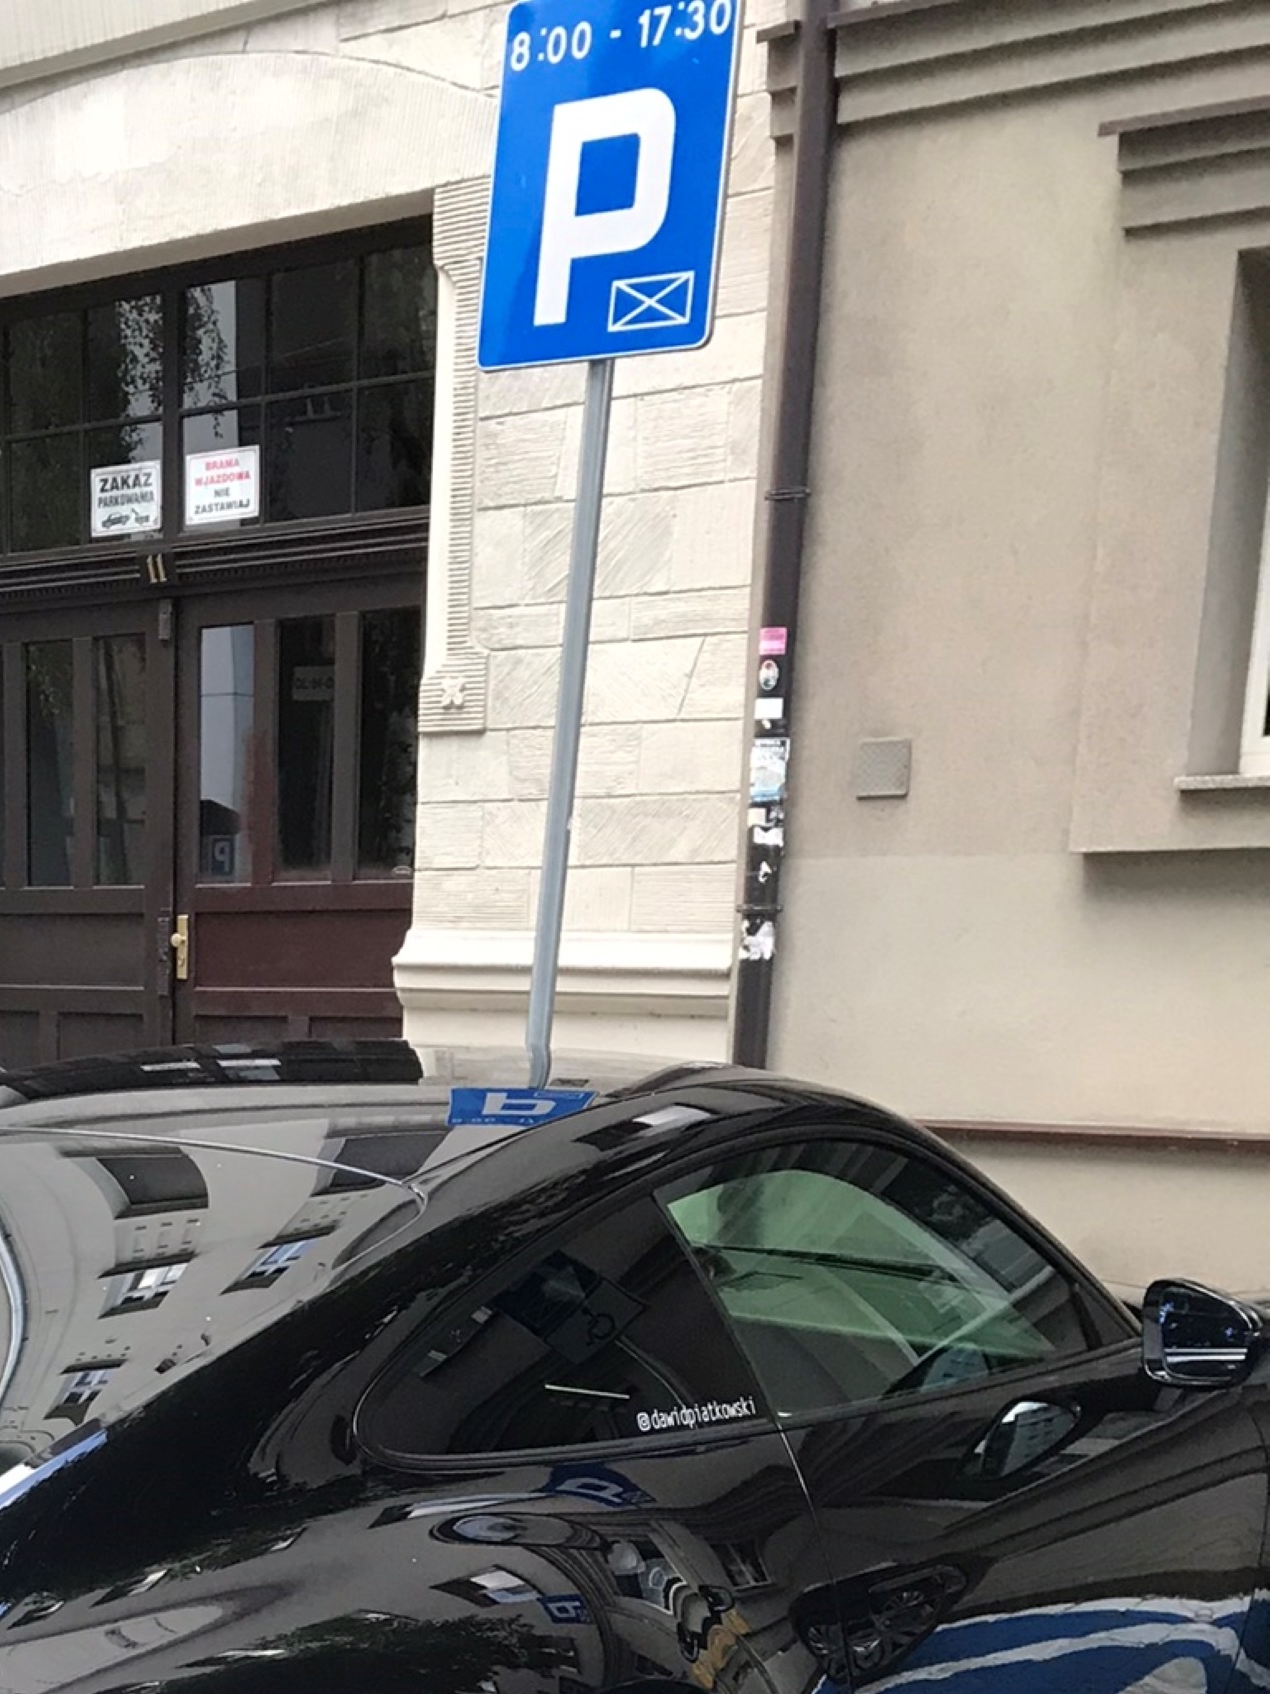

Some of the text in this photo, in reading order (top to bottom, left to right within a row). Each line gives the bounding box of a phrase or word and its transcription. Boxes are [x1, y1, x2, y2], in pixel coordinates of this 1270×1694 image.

[510, 21, 592, 71] 8:00
[638, 0, 731, 48] 17:30
[534, 88, 676, 326] P
[205, 458, 240, 471] BRAMA
[99, 472, 153, 493] ZAKAZ
[194, 470, 251, 487] WJAZDOWA
[97, 491, 154, 508] PARKOWANIA
[214, 487, 230, 498] NIE
[194, 499, 250, 515] ZASTAWIAJ
[636, 1397, 756, 1432] @dawidpiatkowski
